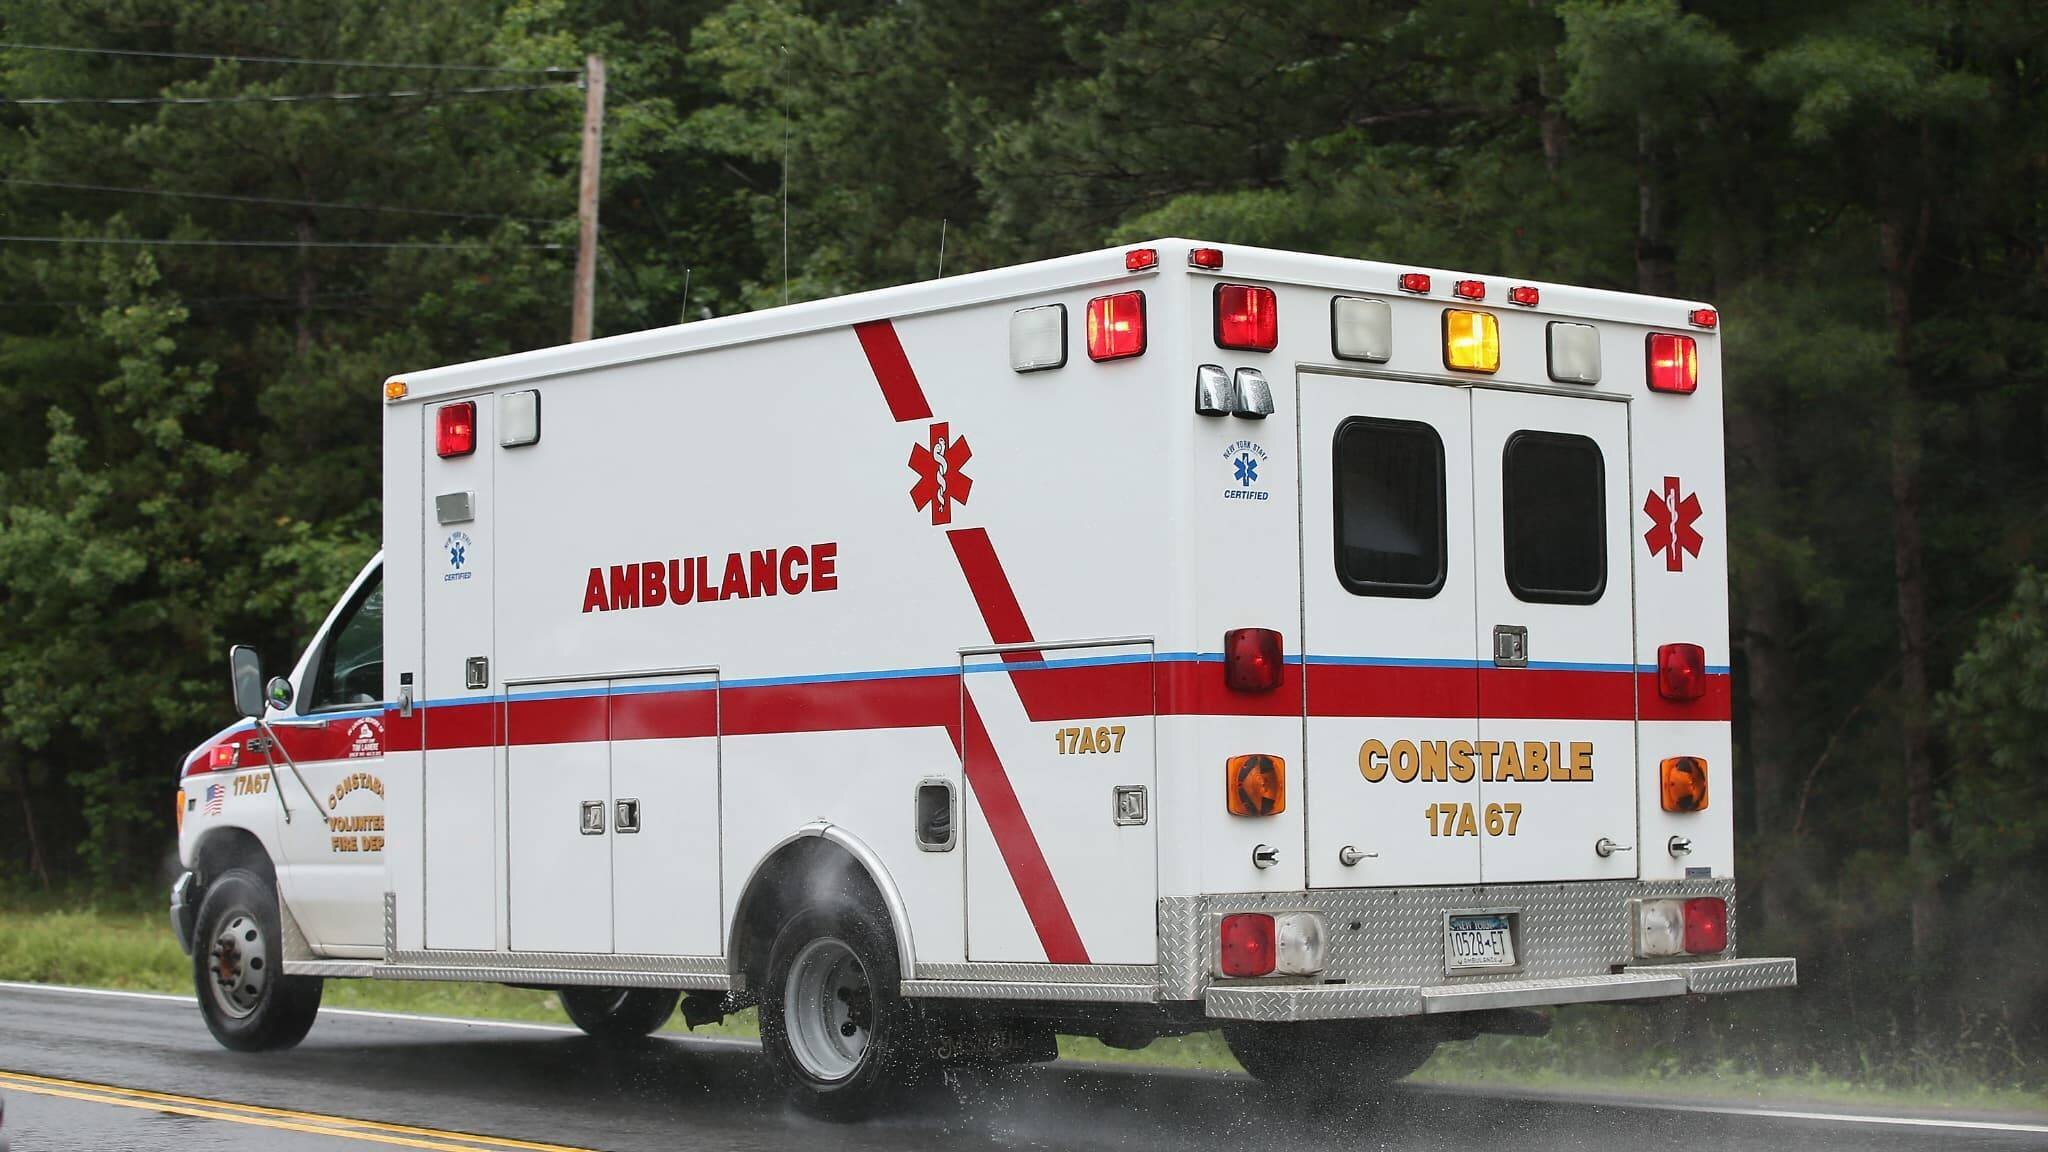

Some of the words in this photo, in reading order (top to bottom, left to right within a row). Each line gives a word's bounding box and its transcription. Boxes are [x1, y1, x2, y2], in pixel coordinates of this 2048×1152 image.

[1224, 489, 1269, 501] CERTIFIED
[445, 572, 472, 581] CERTIFIED
[582, 542, 838, 613] AMBULANCE
[1055, 725, 1126, 755] 17A67
[1358, 738, 1595, 783] CONSTABLE
[233, 773, 271, 796] 17A67
[331, 836, 358, 853] FIRE
